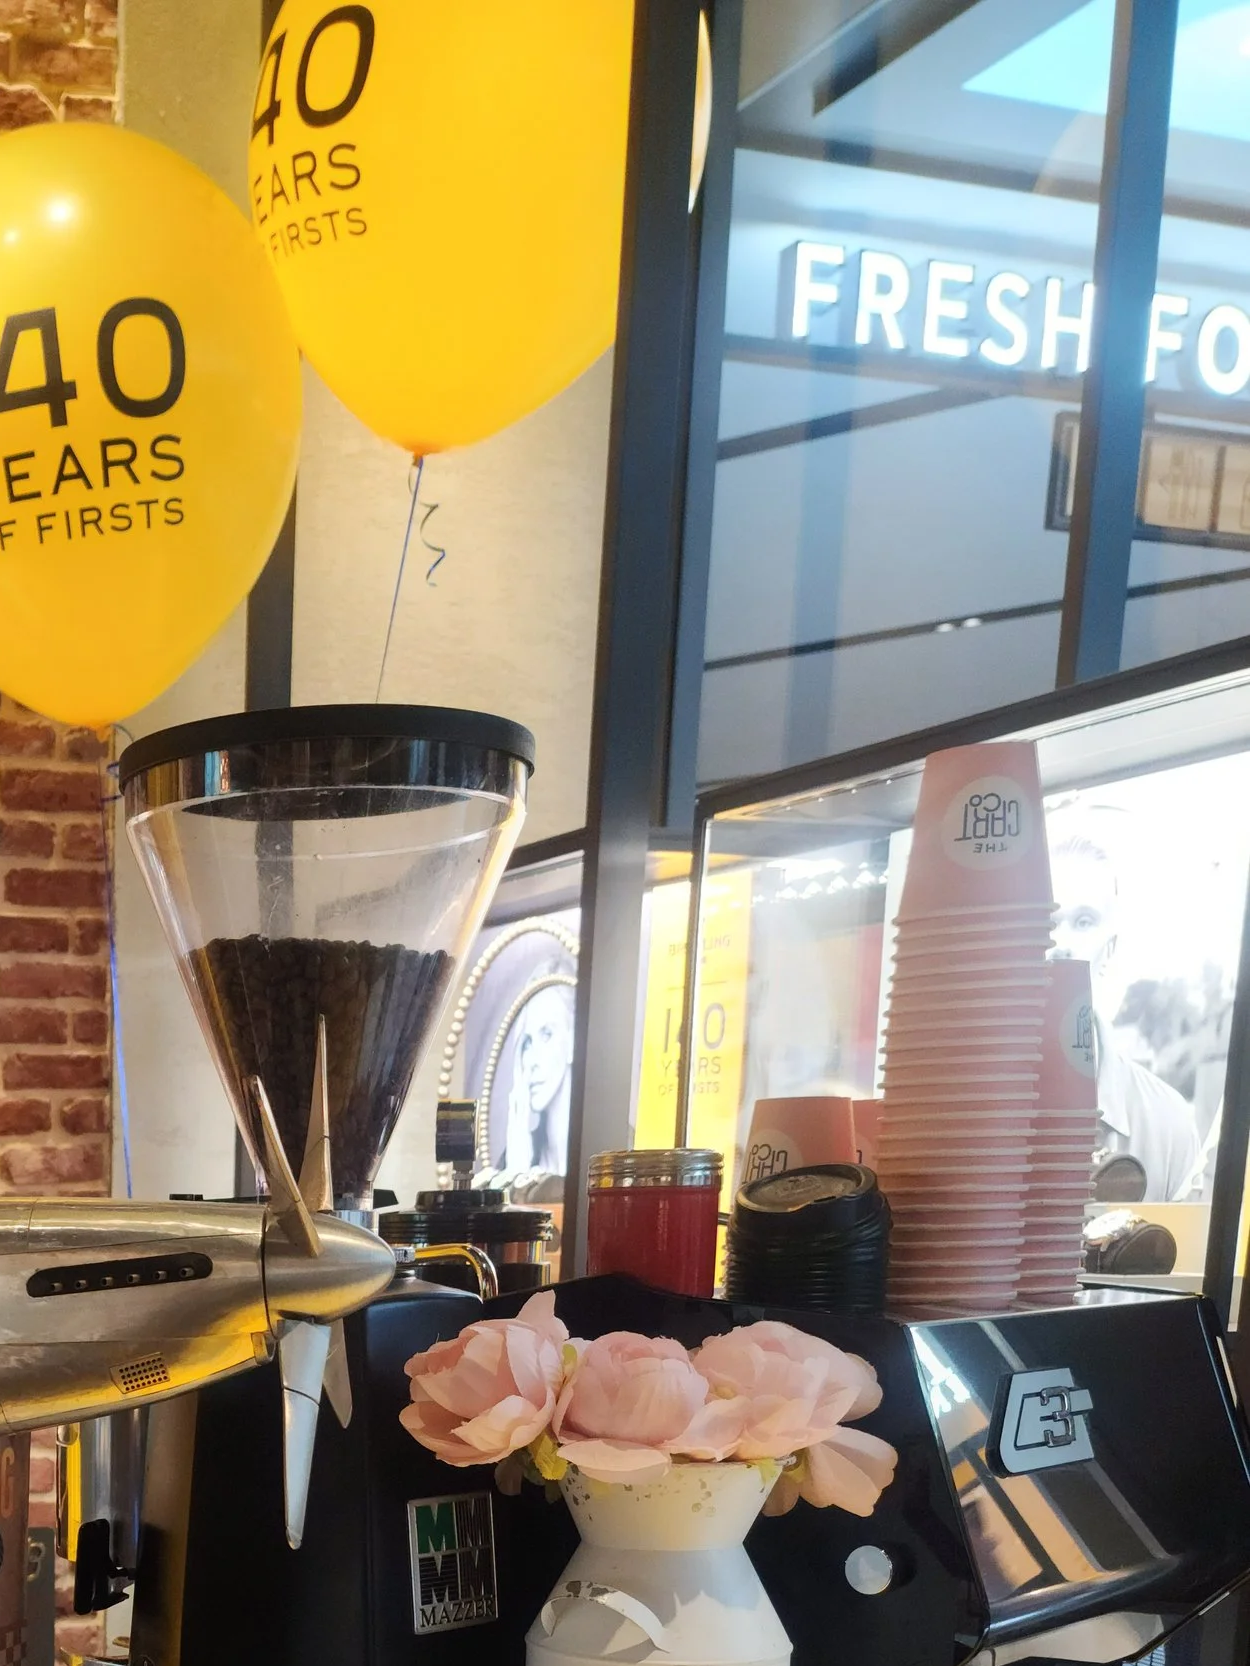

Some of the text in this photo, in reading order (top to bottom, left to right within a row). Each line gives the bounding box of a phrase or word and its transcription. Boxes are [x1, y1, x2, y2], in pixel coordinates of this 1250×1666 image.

[253, 143, 361, 225] EARS
[791, 240, 1095, 374] FRESH
[36, 497, 186, 546] FIRSTS
[664, 1003, 726, 1053] 10
[419, 1598, 494, 1628] MAZZER
